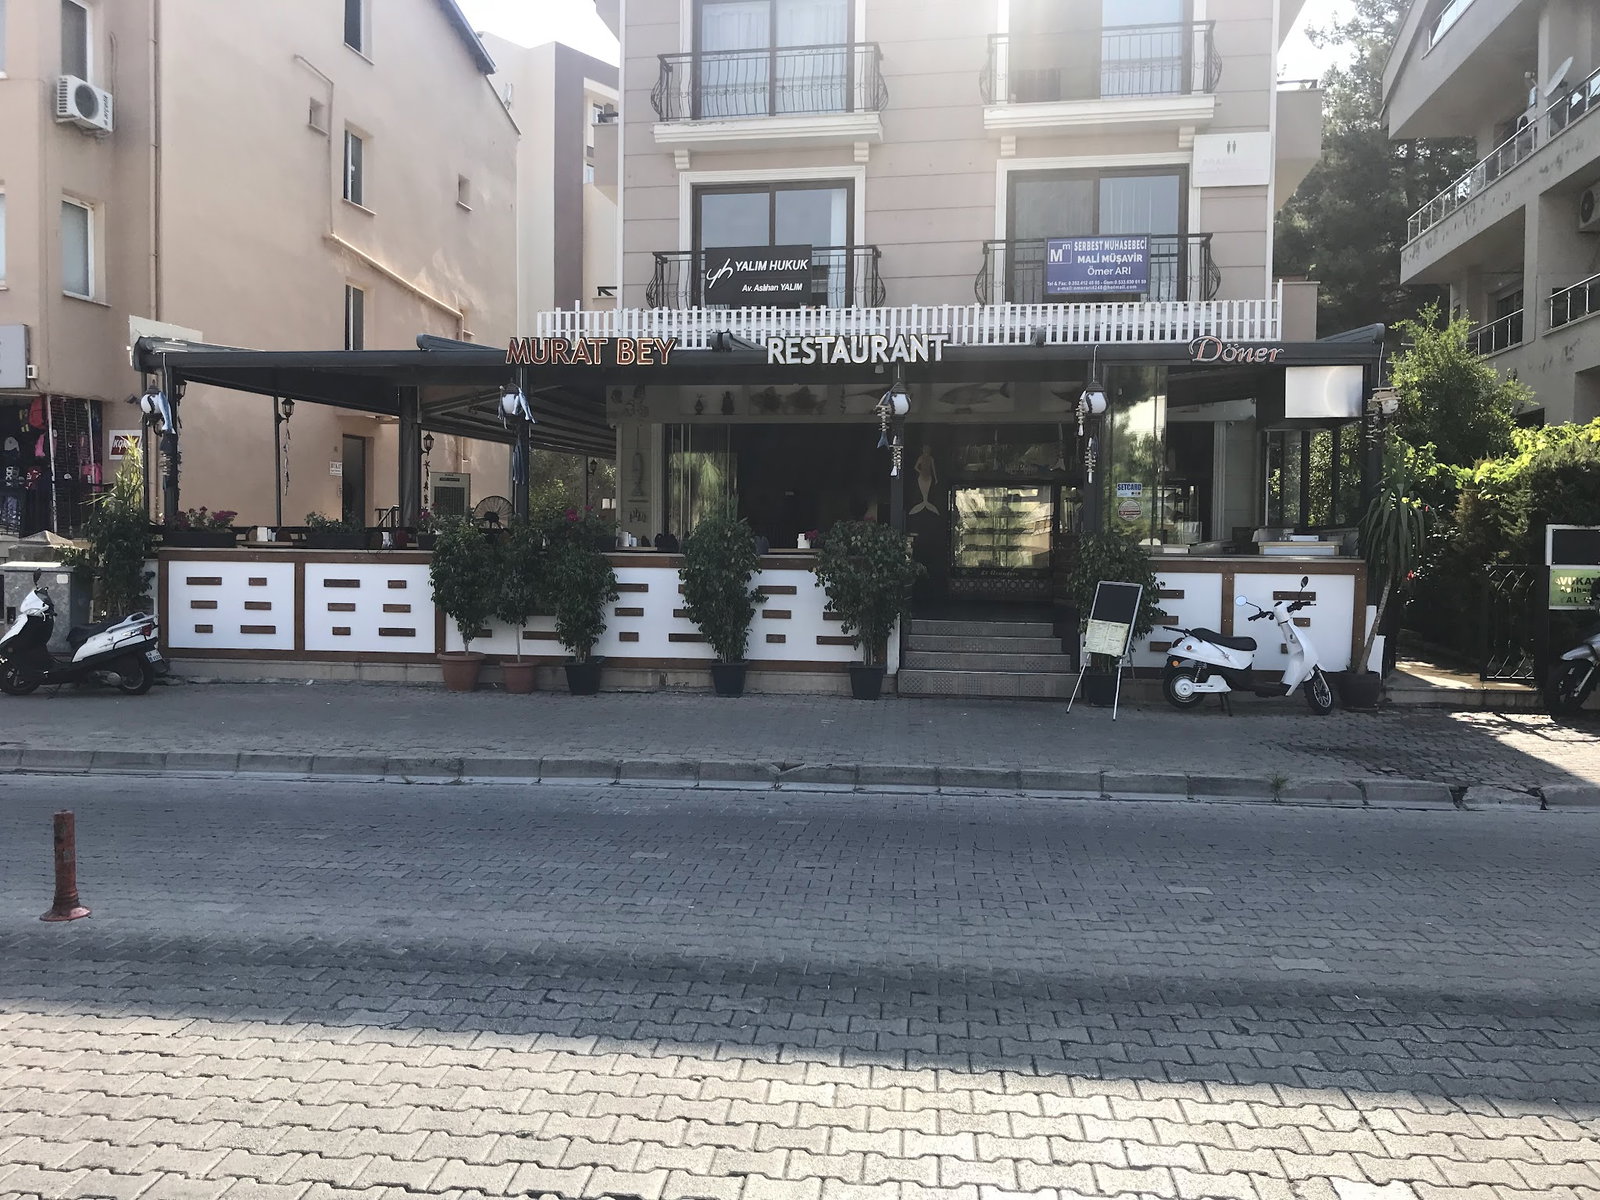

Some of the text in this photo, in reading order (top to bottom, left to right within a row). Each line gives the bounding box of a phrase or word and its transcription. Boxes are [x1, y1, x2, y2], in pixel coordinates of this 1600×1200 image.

[1074, 237, 1148, 251] SERBEST MUHASEBECİ
[1077, 252, 1143, 264] MALİ MÜŞAVİR
[735, 259, 809, 272] YALIM HUKUK
[1087, 266, 1131, 276] Ömer ARI
[742, 284, 752, 292] Av.
[780, 283, 803, 291] YALIM
[505, 337, 677, 365] MURAT BEY
[767, 333, 950, 365] RESTAURANT
[1188, 335, 1285, 363] Döner
[1117, 483, 1142, 491] SETCARD
